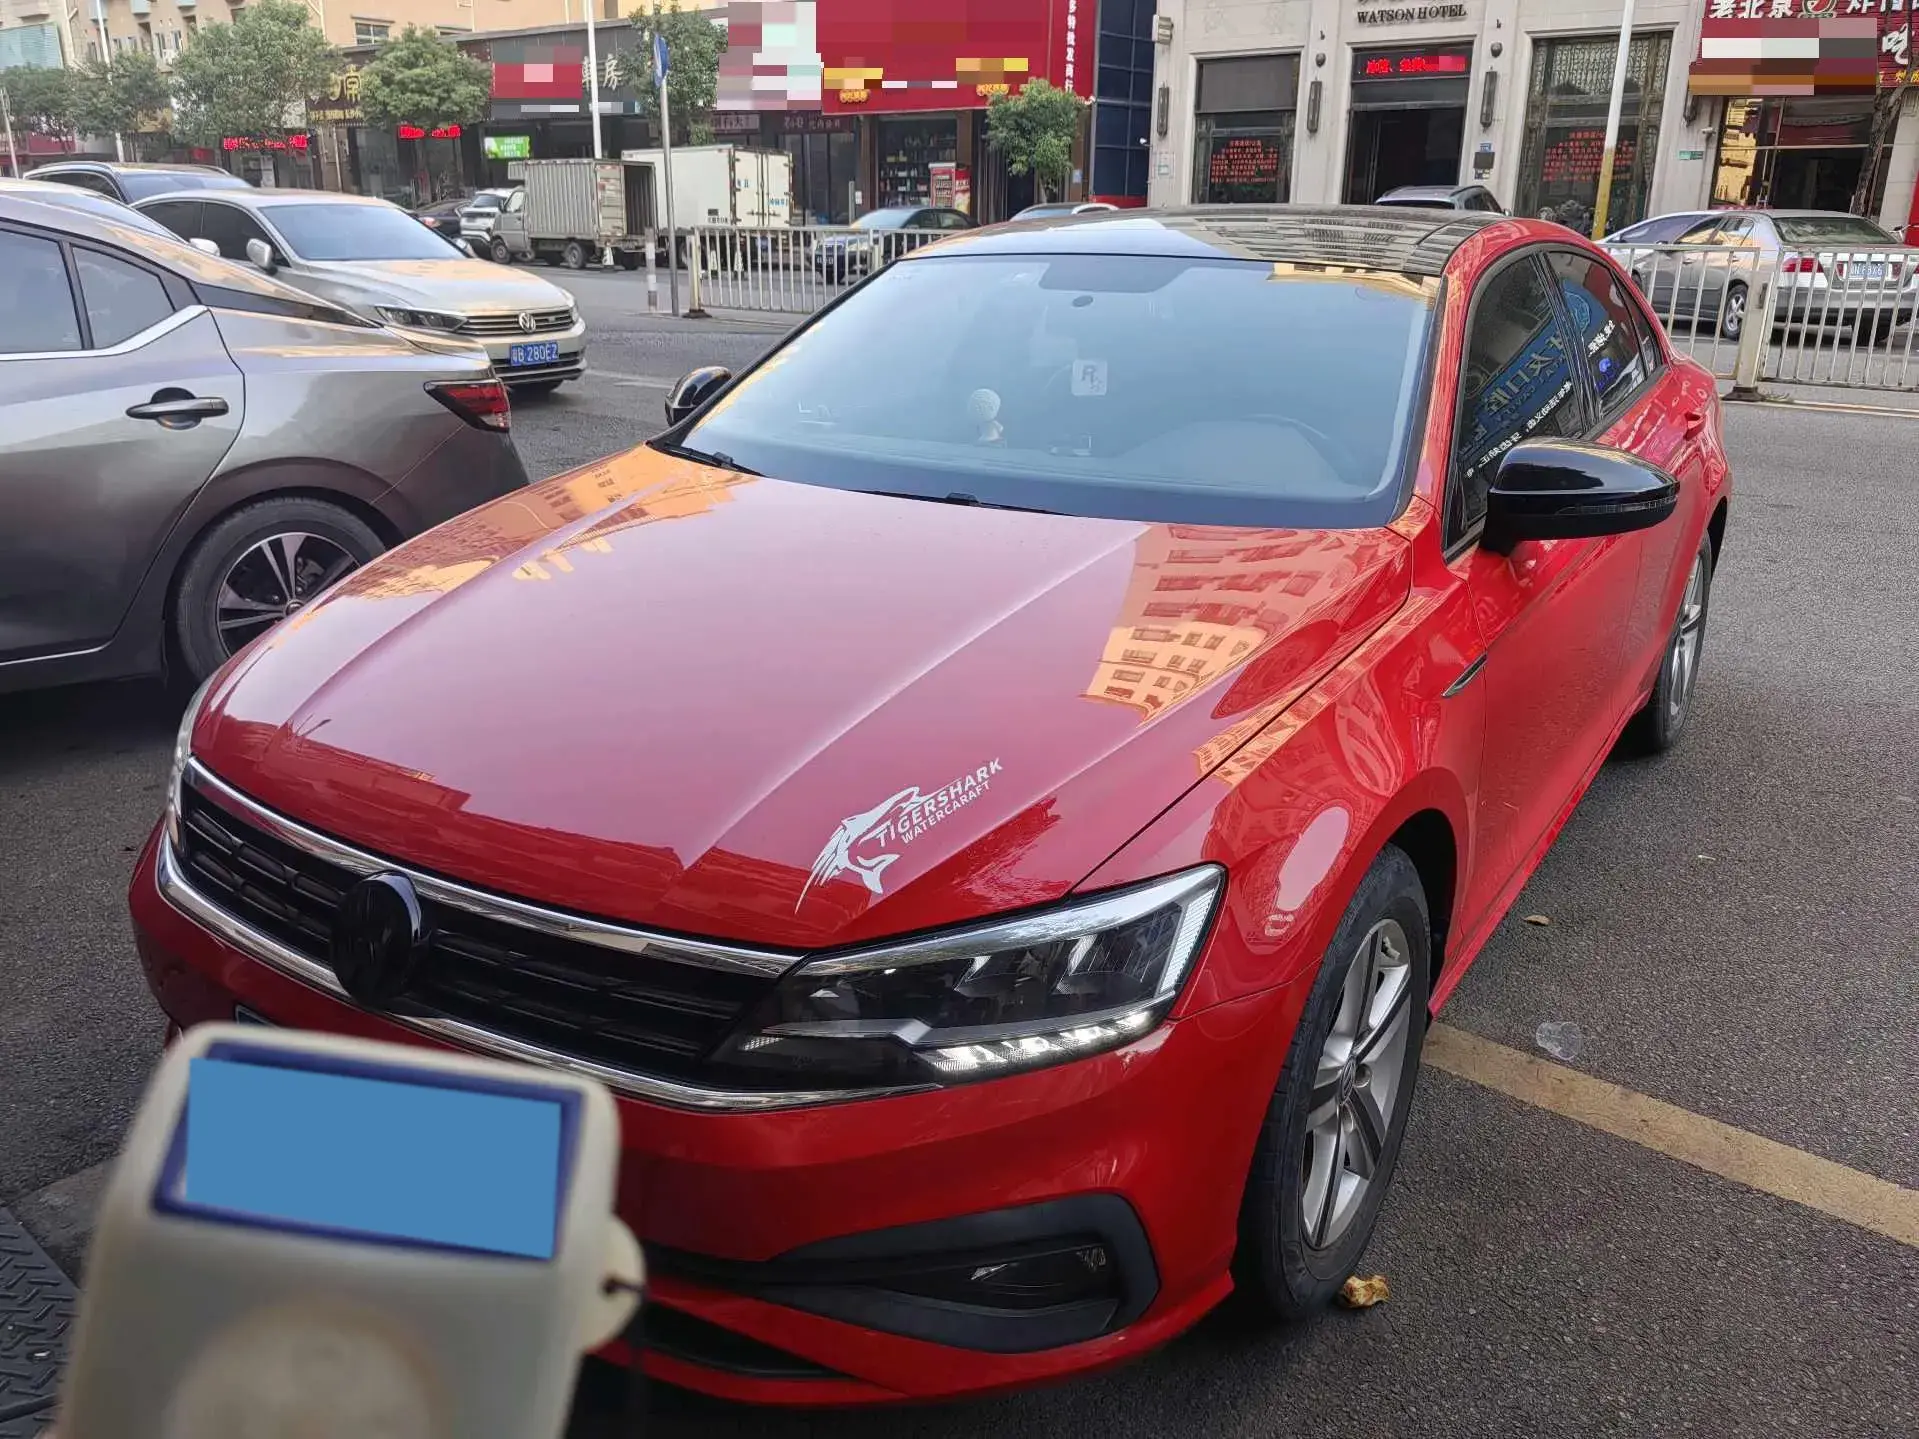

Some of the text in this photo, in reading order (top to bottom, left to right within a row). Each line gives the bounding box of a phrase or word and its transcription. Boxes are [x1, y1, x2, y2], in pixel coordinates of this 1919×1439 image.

[1357, 4, 1467, 23] WATSON HOTEL
[875, 757, 1003, 847] TIGERSHARK
[901, 780, 990, 844] WATERCARAFT
